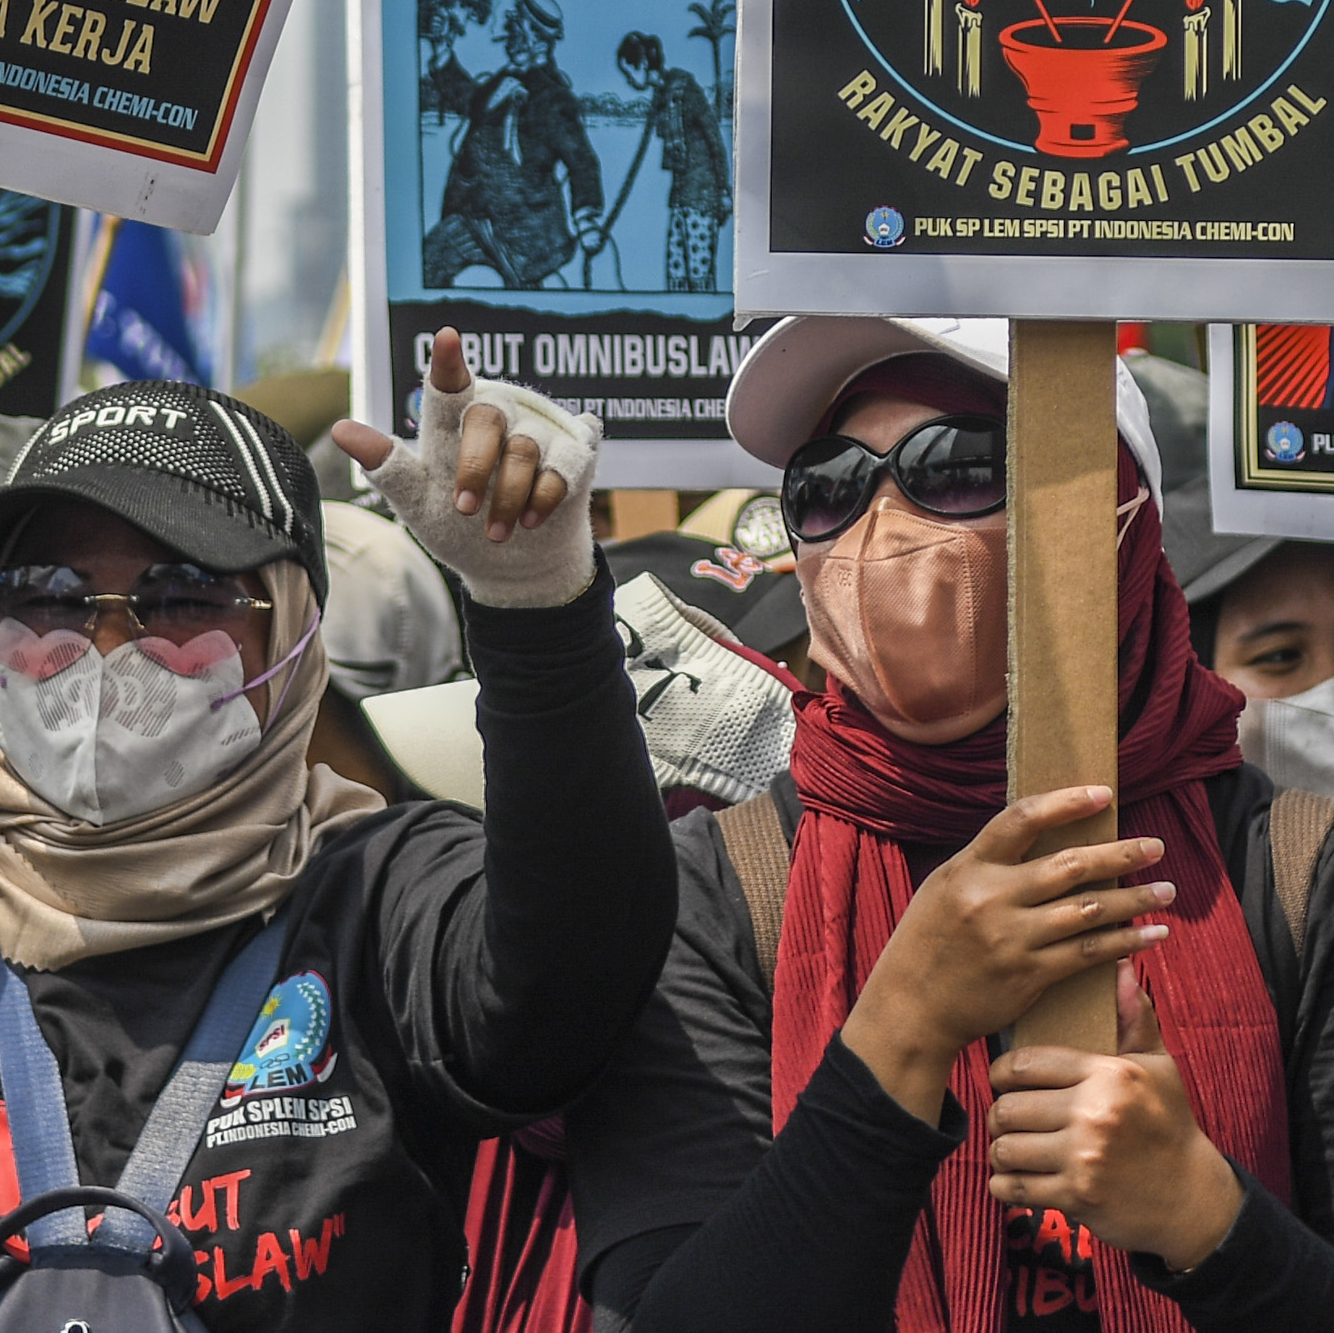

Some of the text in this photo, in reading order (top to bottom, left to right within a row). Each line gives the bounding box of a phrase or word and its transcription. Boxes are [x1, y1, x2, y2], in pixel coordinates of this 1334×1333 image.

[20, 0, 156, 75] KERJA
[93, 84, 199, 131] CHEMI-CON
[837, 69, 984, 188] RAKYAT
[989, 160, 1169, 212] SEBAGAI
[1176, 82, 1327, 193] TUMBAL
[914, 217, 1295, 242] PUK SP LEM SPSI PT INDONESIA CHEMI-CON
[414, 332, 525, 376] CBUT
[48, 405, 187, 446] SPORT
[607, 398, 691, 420] INDONESIA
[257, 1024, 286, 1052] SPSI
[250, 1063, 307, 1091] LEM
[207, 1104, 248, 1135] PUK
[307, 1096, 354, 1122] SPSI
[292, 1116, 357, 1138] CHEMI-CON
